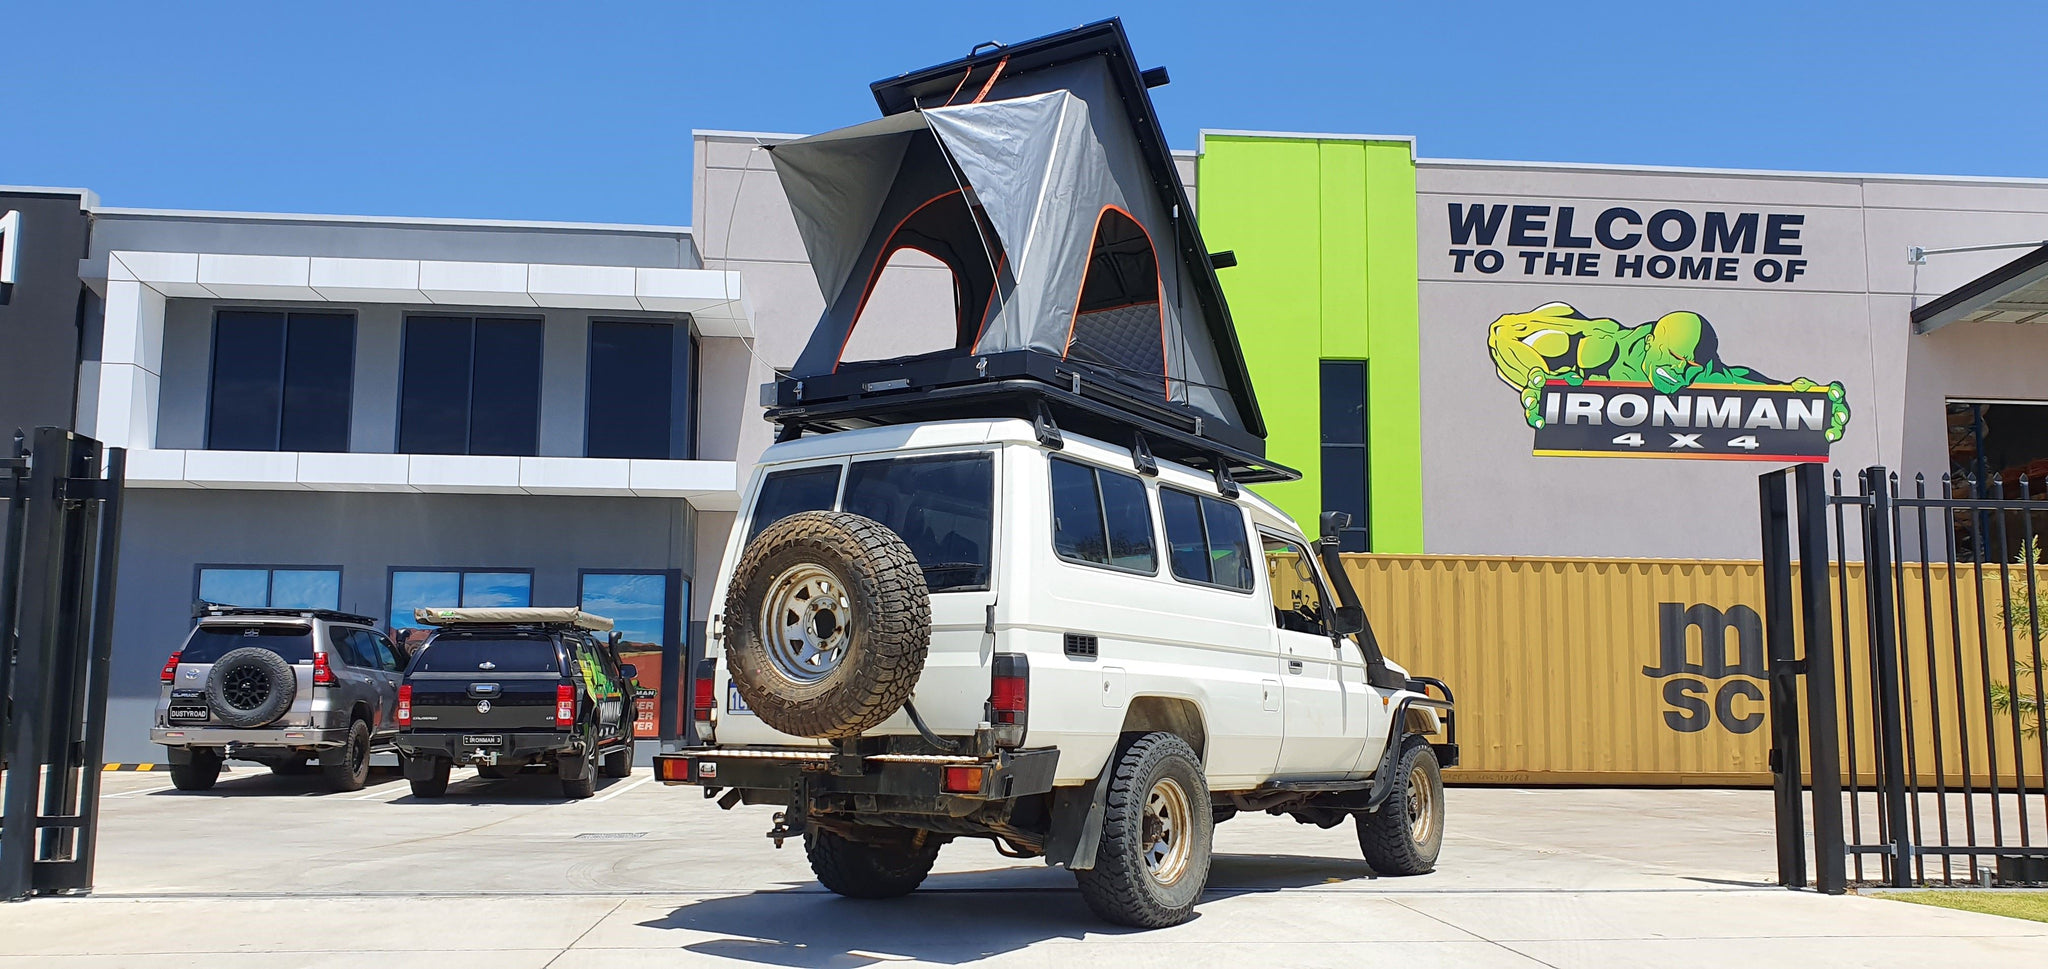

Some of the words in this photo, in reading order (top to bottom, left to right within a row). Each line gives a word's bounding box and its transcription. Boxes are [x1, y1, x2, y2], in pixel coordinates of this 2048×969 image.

[1447, 203, 1805, 255] WELCOME
[1448, 248, 1505, 274] TO
[1518, 251, 1600, 278] THE
[1615, 254, 1739, 281] HOME
[1753, 258, 1807, 283] OF
[1545, 392, 1825, 431] IRONMAN
[1612, 432, 1645, 448] 4
[1727, 435, 1759, 450] 4
[171, 710, 206, 718] DUSTYROAD
